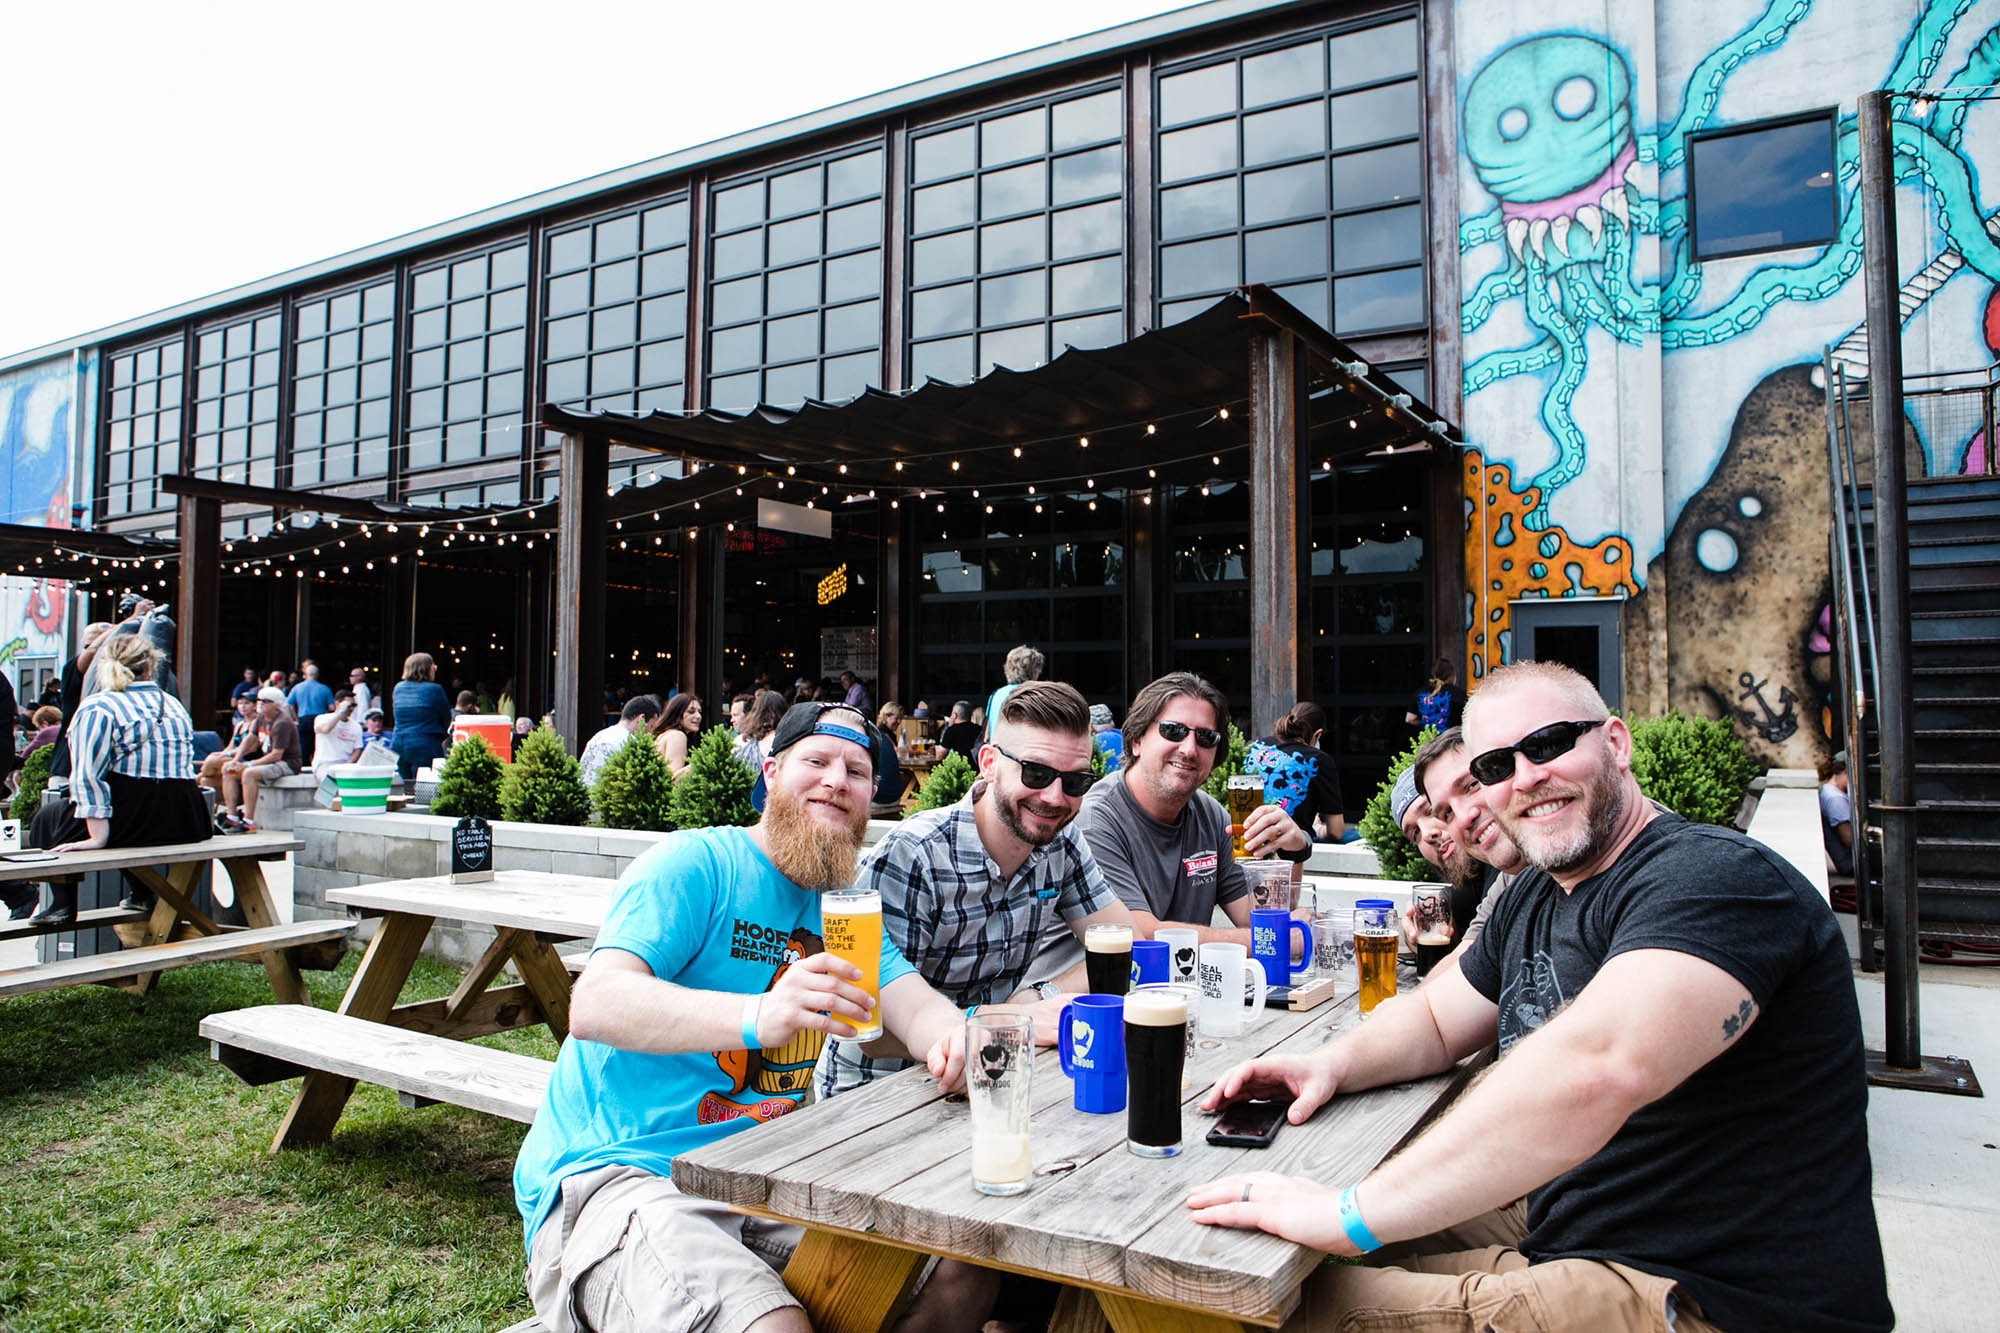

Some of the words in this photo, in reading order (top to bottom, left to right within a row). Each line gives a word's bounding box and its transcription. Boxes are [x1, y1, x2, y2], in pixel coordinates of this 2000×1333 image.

[733, 919, 789, 945] HOOF
[825, 926, 846, 935] BEER
[1254, 926, 1273, 935] REAL
[836, 934, 855, 942] THE
[1254, 932, 1276, 942] BEER
[731, 936, 782, 955] HEARTE
[1318, 944, 1339, 952] CRAFT
[730, 947, 780, 966] BREWIN
[1203, 991, 1222, 999] ORLD
